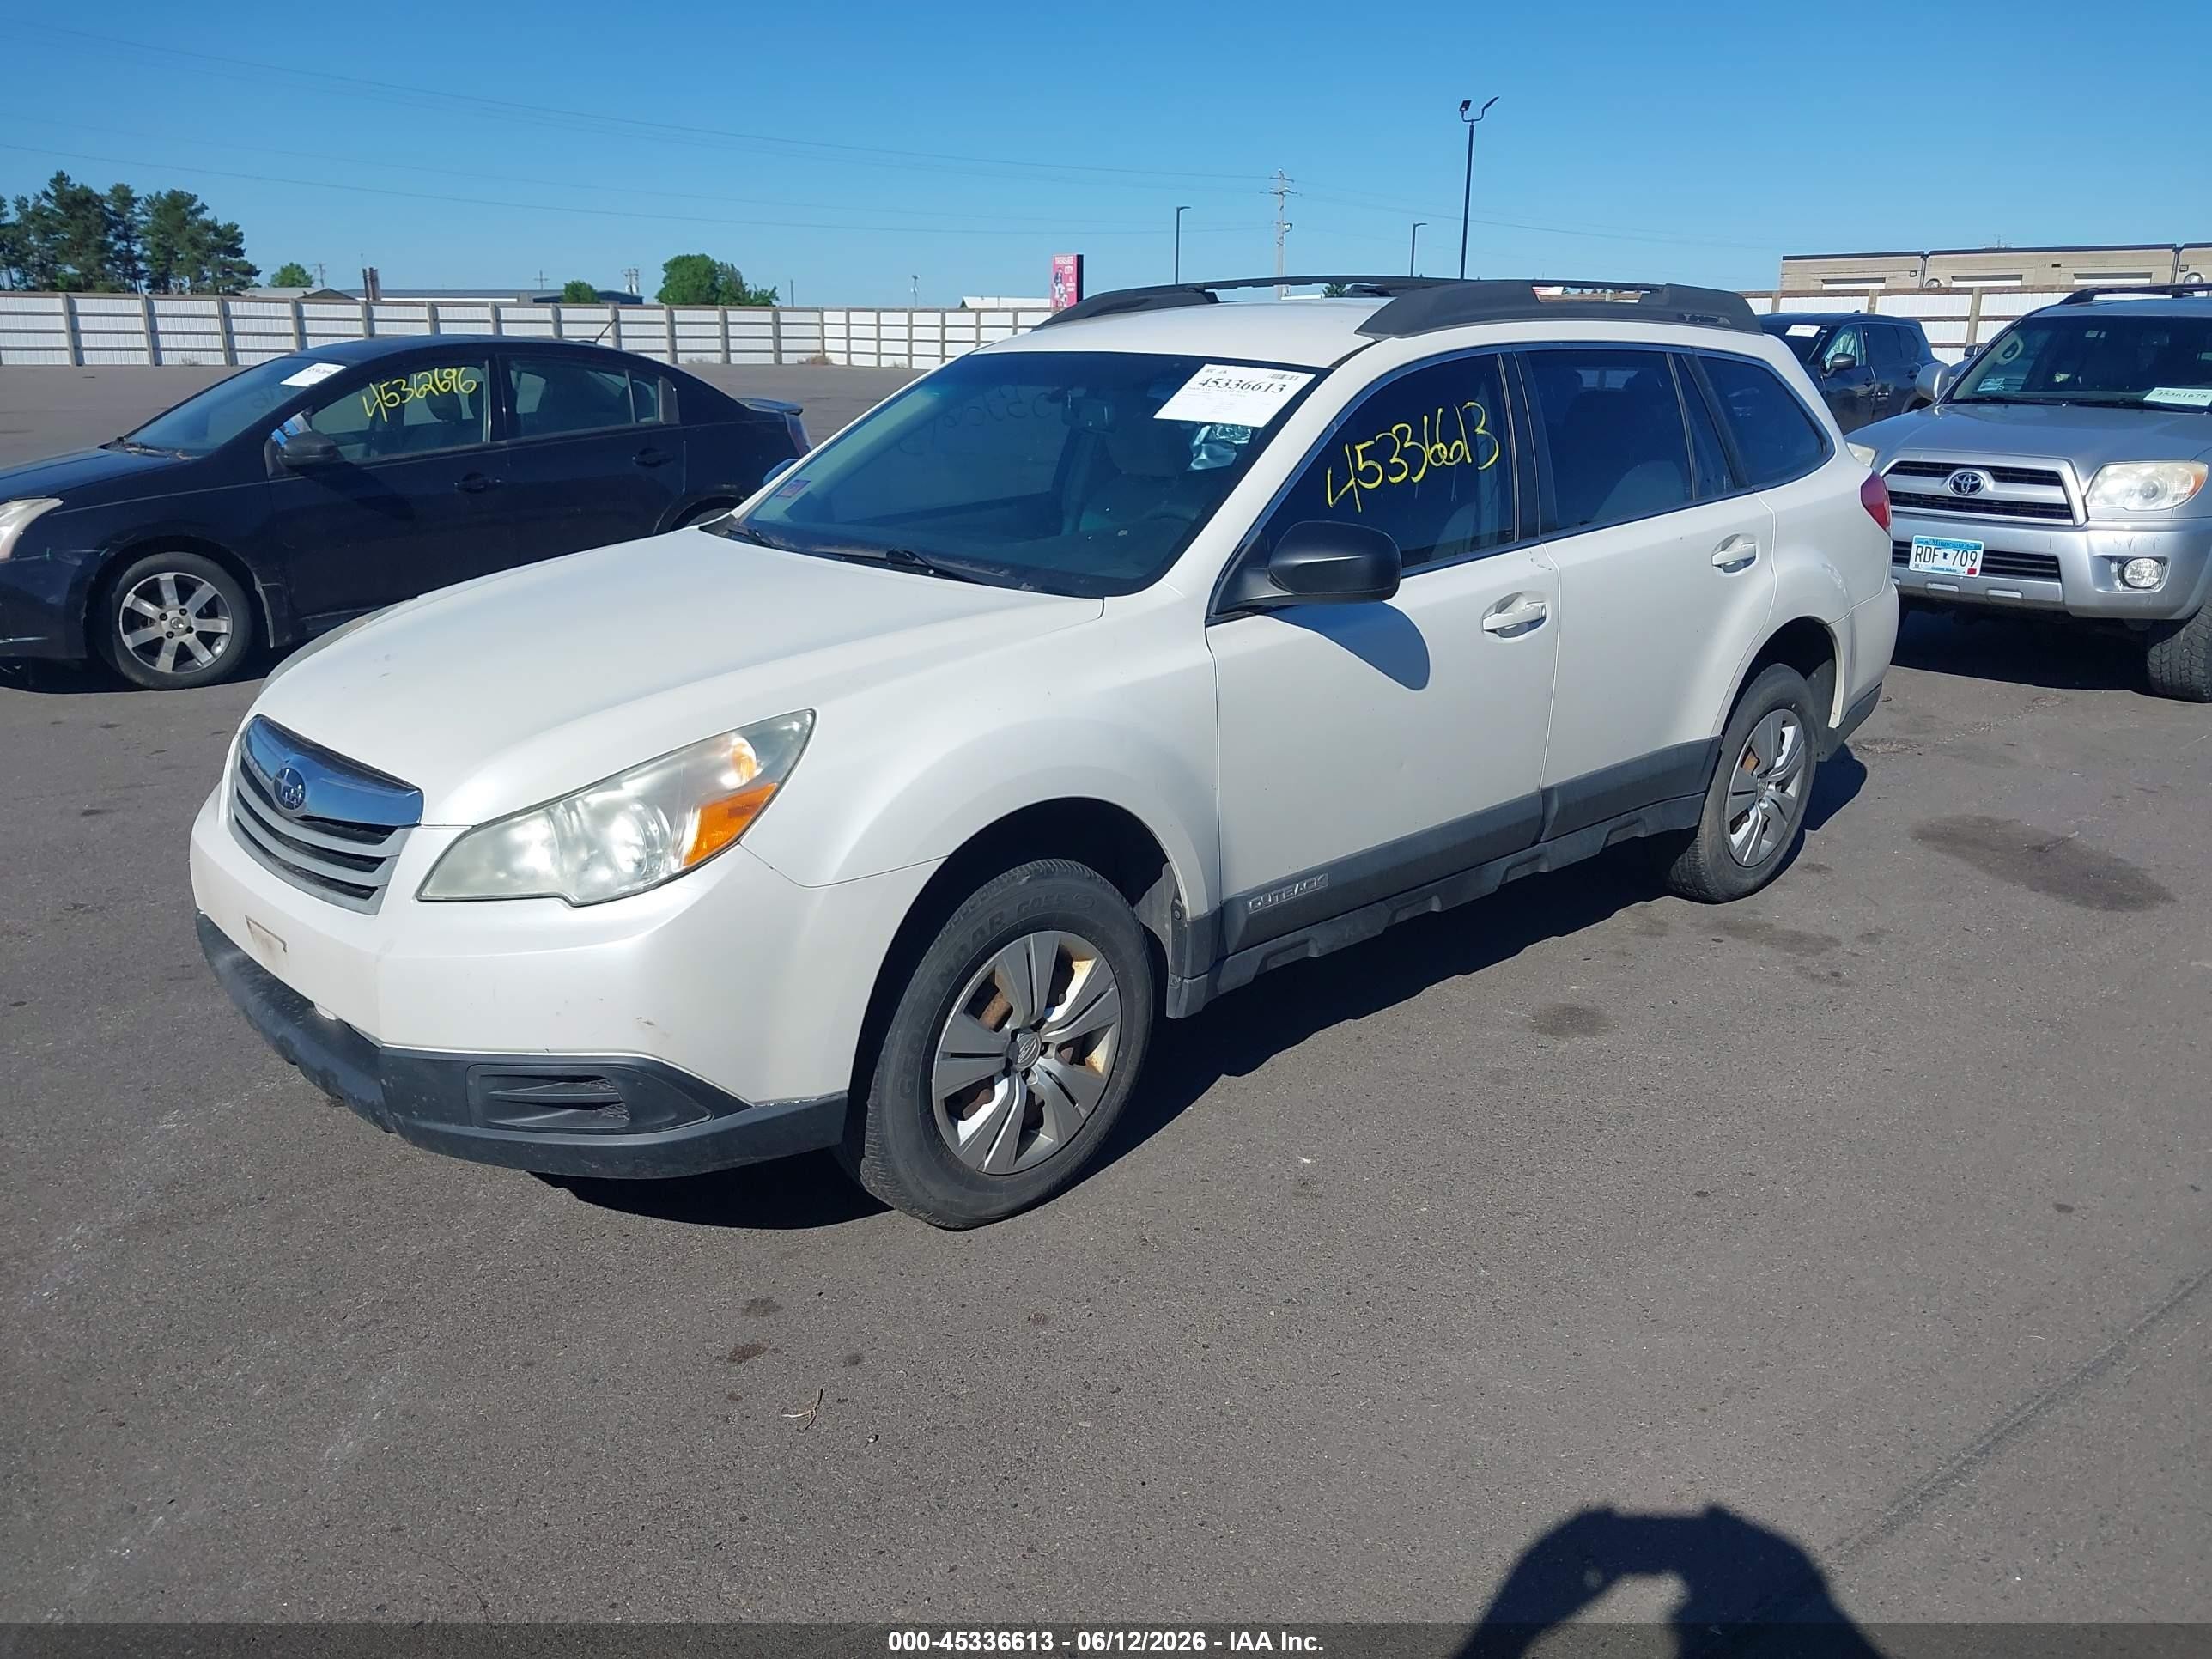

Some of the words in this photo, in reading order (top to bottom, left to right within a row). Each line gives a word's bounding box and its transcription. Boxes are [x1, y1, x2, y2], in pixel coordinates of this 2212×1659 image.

[362, 367, 477, 422] 45362696
[1198, 377, 1287, 394] 45336613
[1327, 401, 1499, 513] 45336613
[1914, 545, 1942, 563] RDF
[1952, 549, 1978, 568] 709
[1249, 874, 1328, 912] OUTBACK
